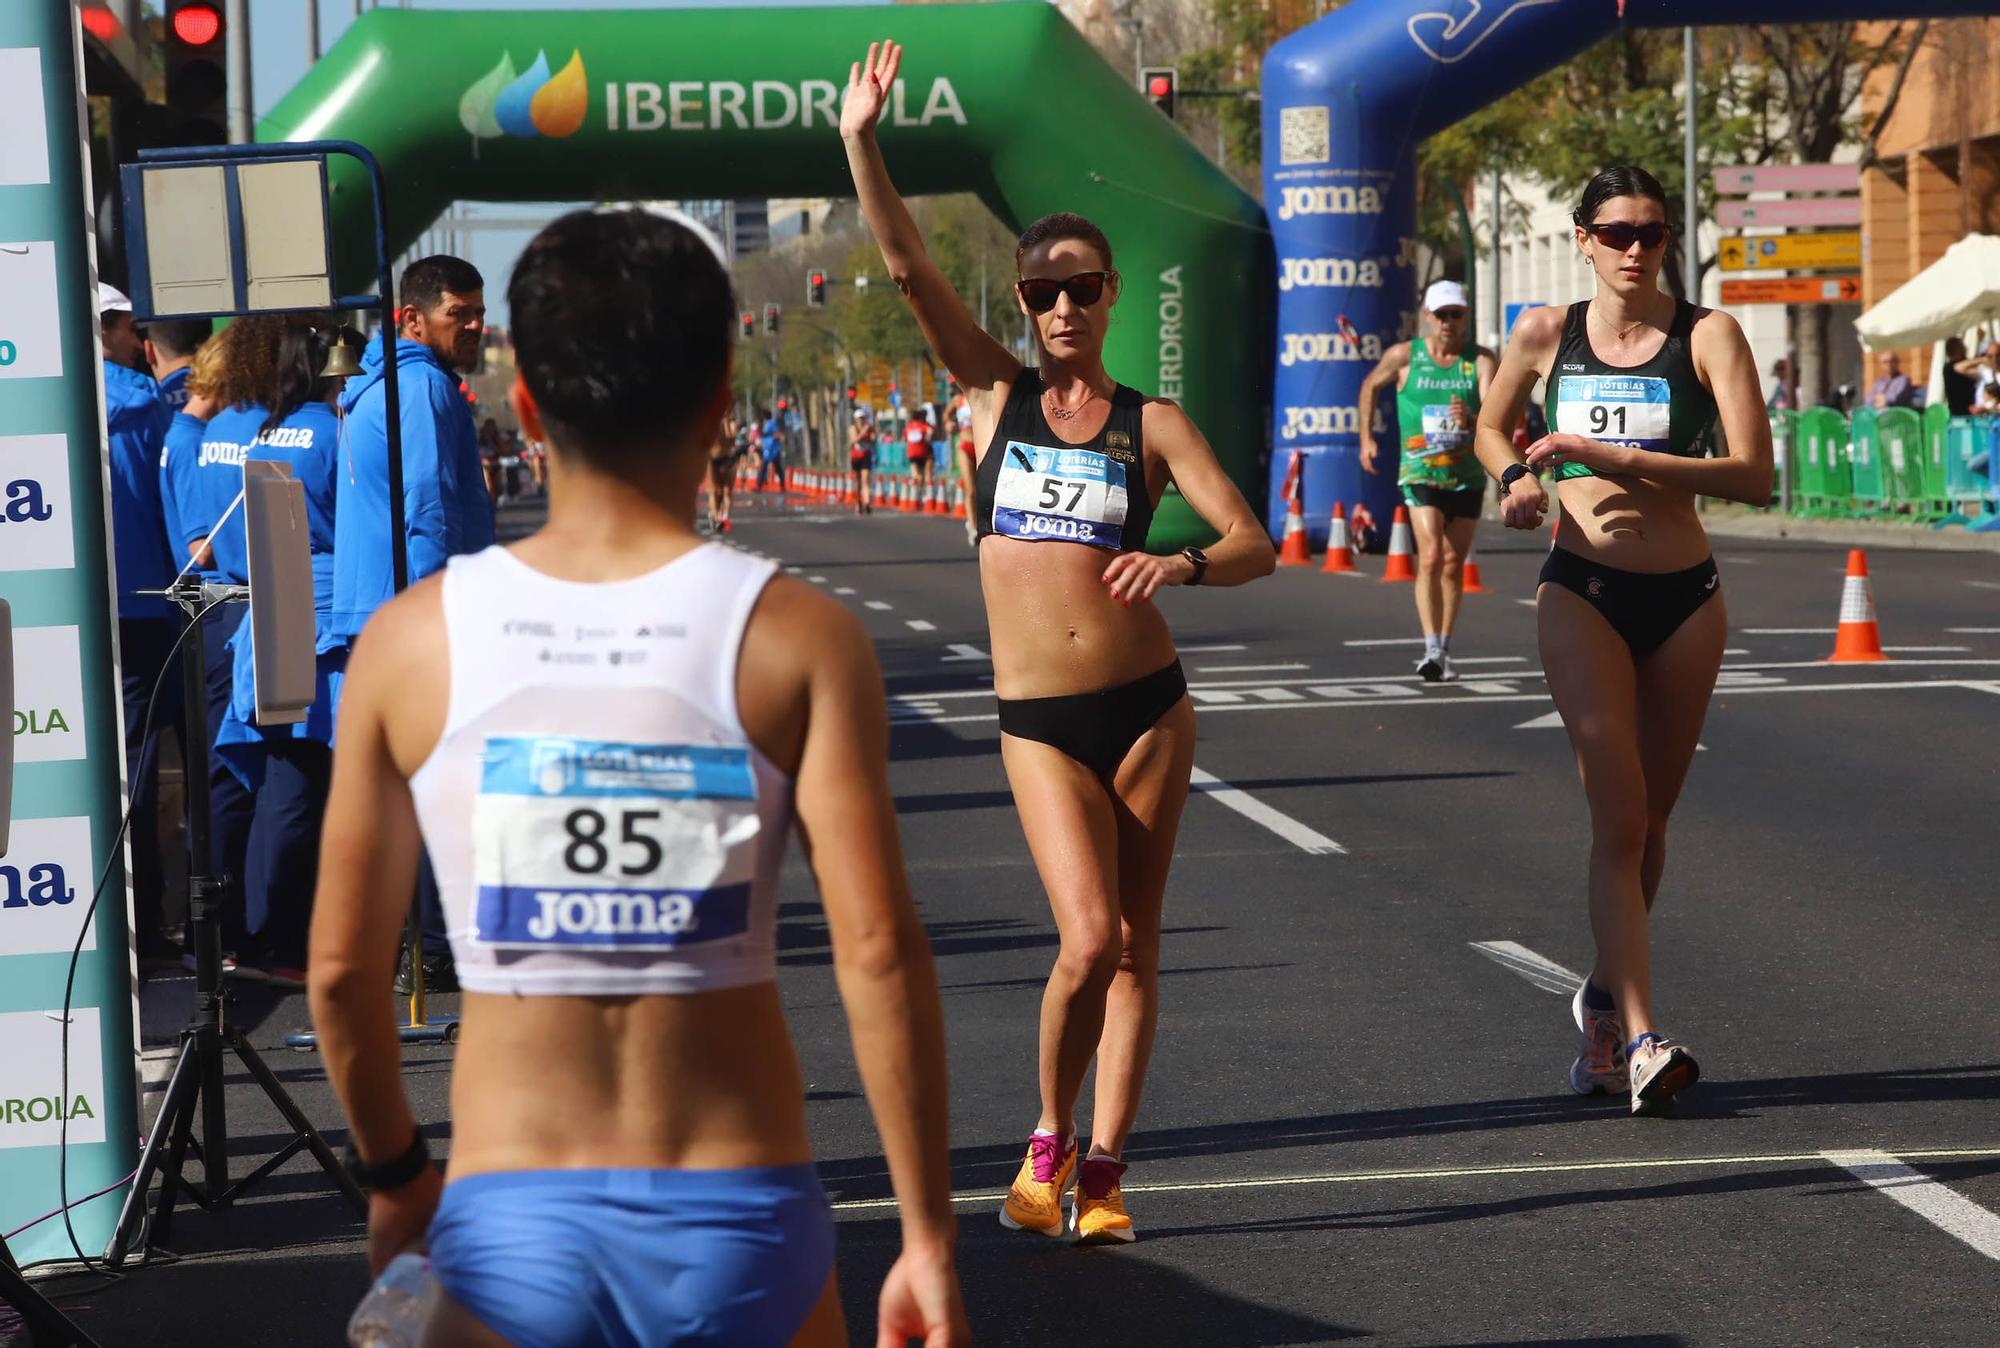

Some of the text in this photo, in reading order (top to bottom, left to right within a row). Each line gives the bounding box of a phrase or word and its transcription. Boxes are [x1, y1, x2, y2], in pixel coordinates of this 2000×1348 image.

[605, 76, 968, 131] IBERDRLA
[1589, 405, 1626, 434] 91
[1039, 478, 1087, 512] 57
[563, 808, 663, 876] 85
